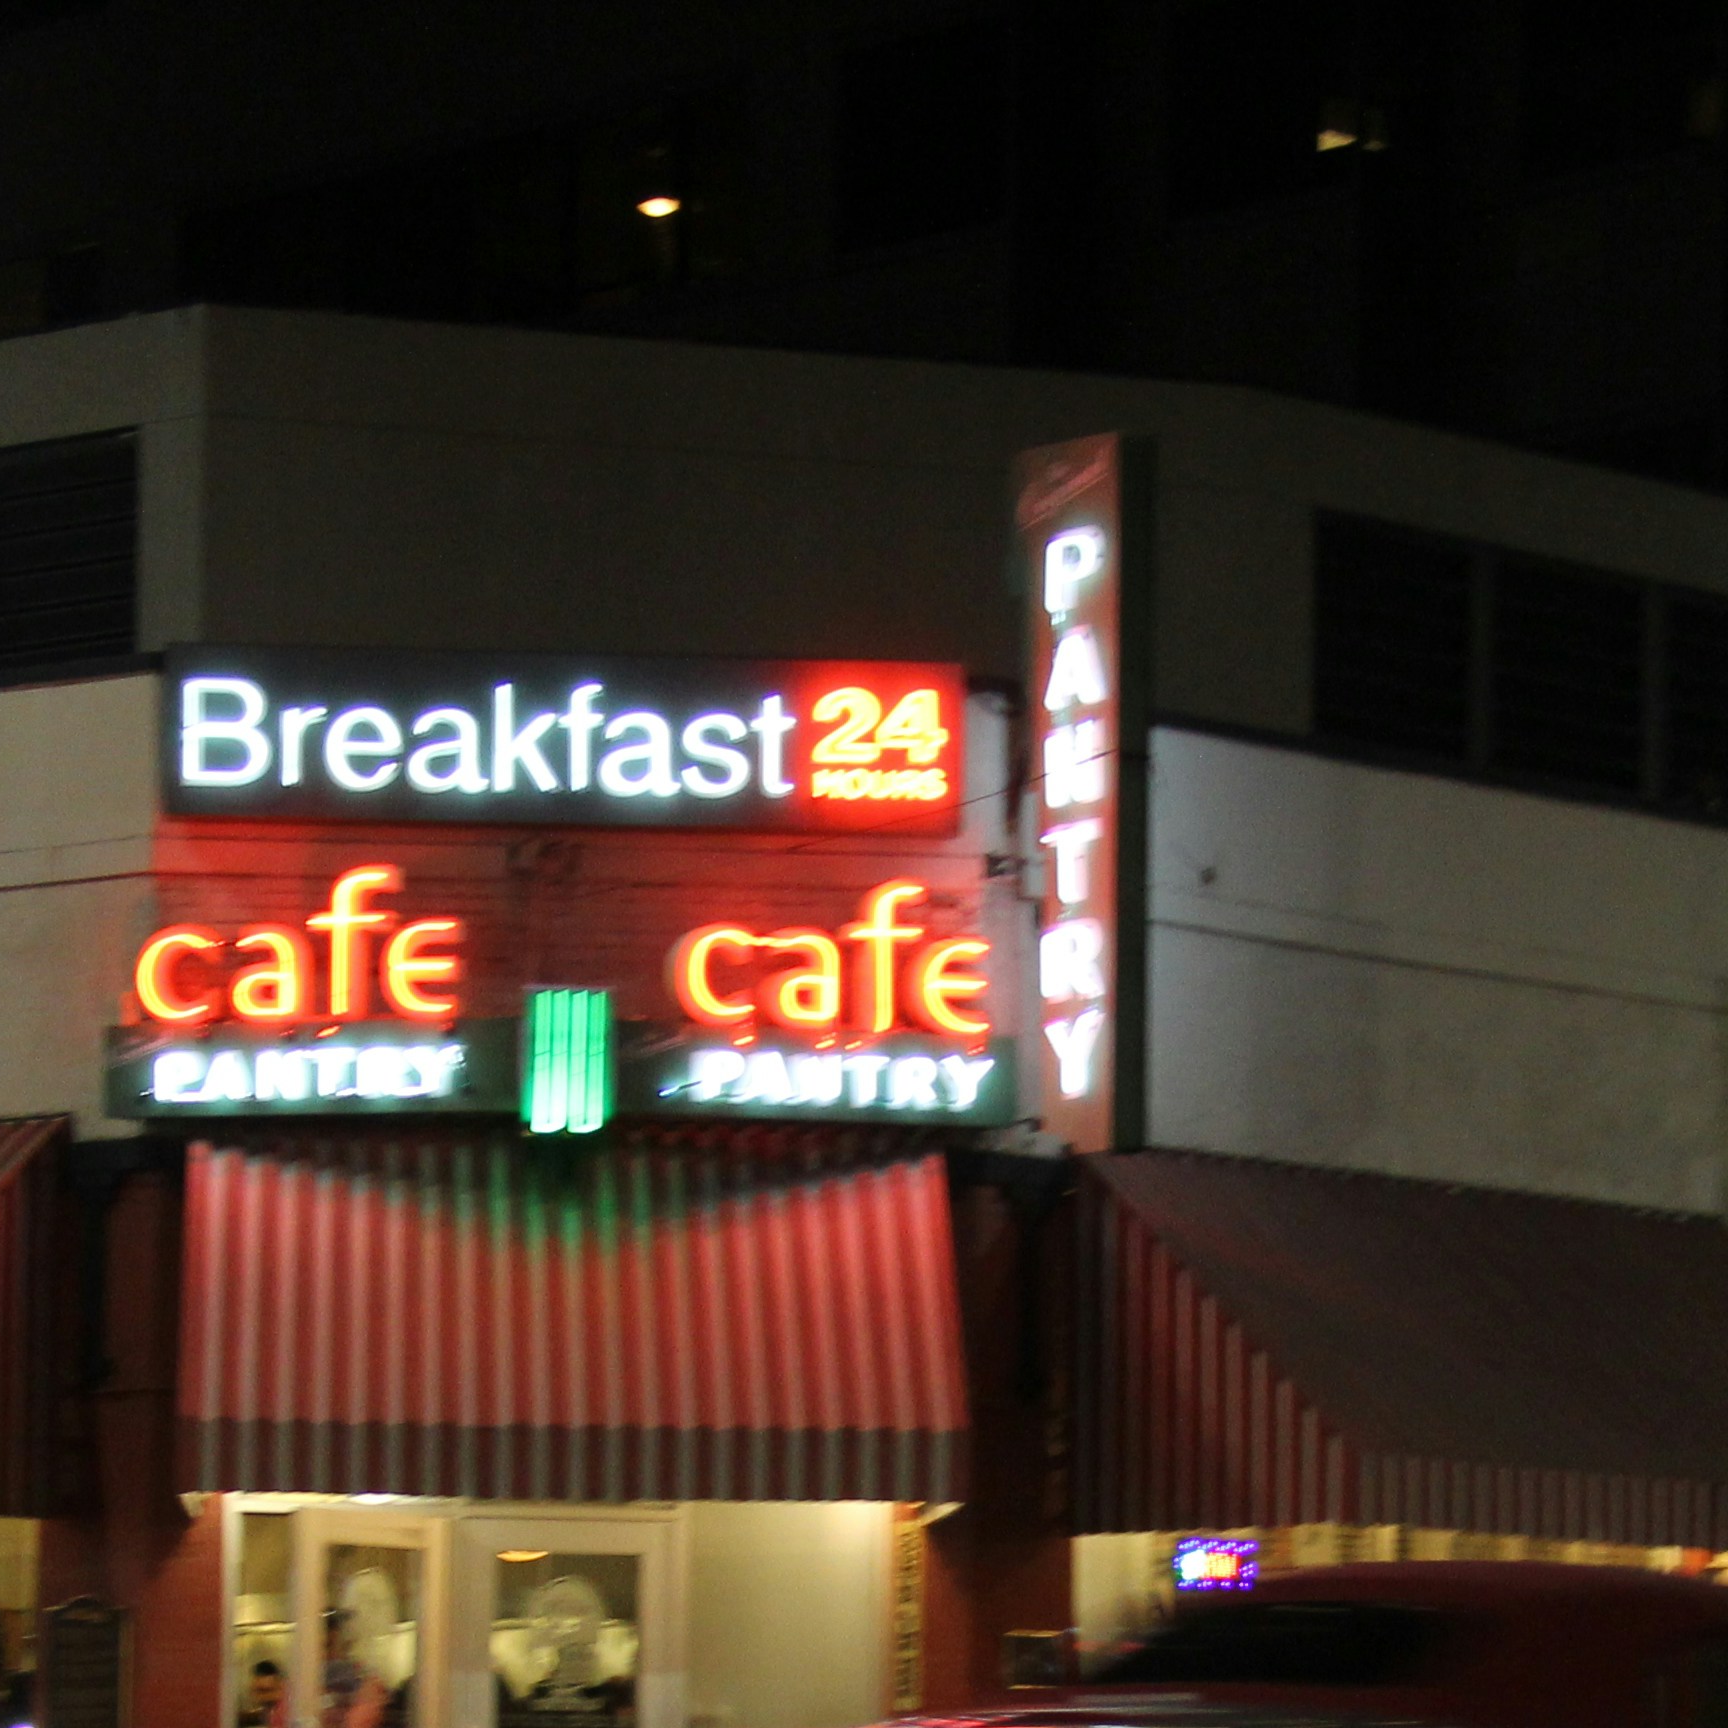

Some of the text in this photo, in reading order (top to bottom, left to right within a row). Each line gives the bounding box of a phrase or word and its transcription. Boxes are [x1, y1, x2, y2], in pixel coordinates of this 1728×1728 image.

[179, 676, 797, 799] Breakfast
[812, 686, 949, 765] 24
[811, 768, 949, 801] HOURS
[1039, 525, 1106, 1099] PANTRY
[135, 864, 466, 1026] cafe
[684, 880, 992, 1036] cafe
[153, 1044, 468, 1103] PANTRY
[688, 1049, 996, 1112] PANTRY
